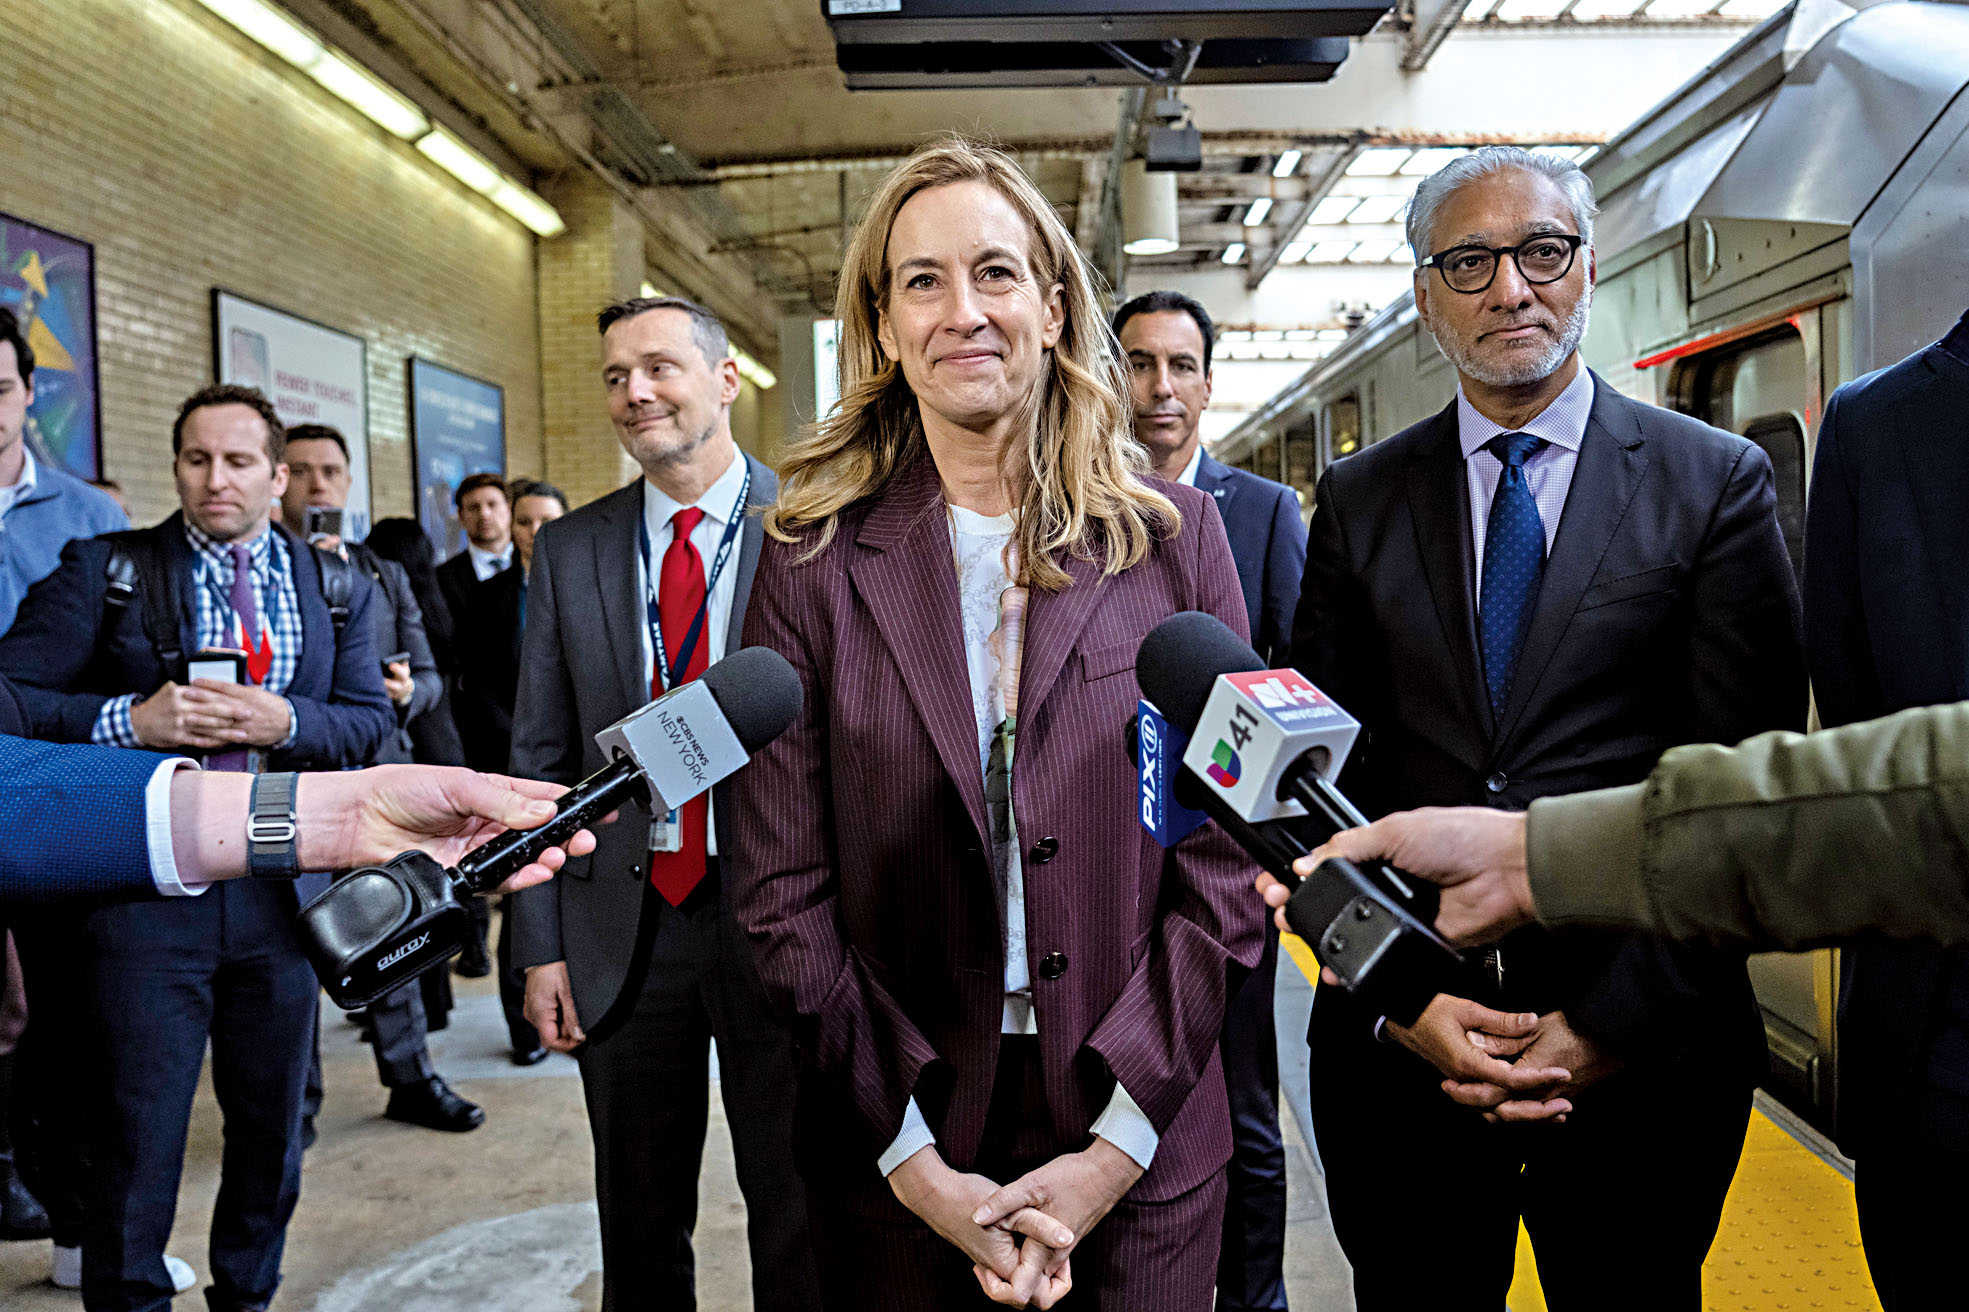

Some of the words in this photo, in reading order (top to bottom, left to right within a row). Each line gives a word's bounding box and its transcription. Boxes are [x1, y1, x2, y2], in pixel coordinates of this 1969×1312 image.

[657, 711, 685, 744] NEW
[678, 744, 708, 786] YORK
[680, 722, 695, 741] CBS
[690, 739, 709, 766] NEWS
[1229, 703, 1260, 751] 41
[376, 931, 431, 971] auray
